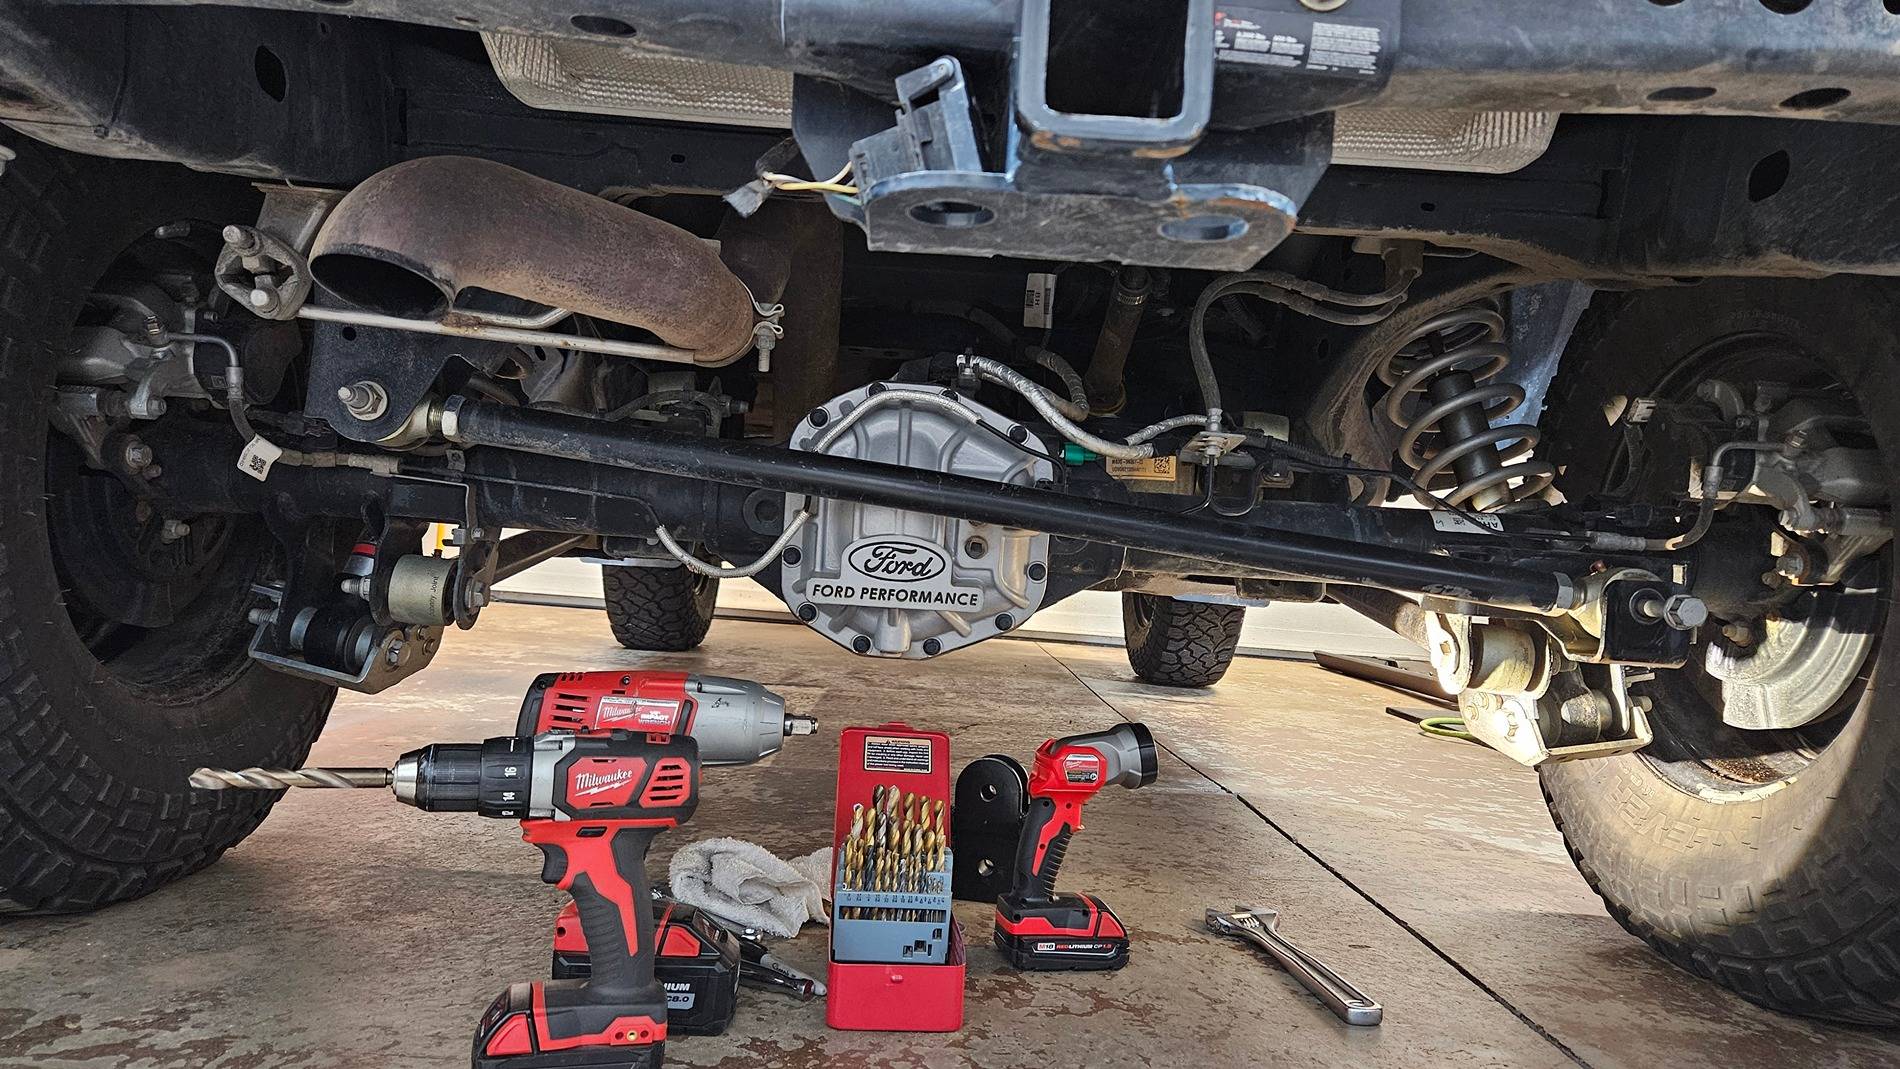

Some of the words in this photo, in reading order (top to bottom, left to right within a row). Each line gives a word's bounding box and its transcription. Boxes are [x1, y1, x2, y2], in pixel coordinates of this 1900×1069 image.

[863, 545, 934, 577] Ford
[812, 584, 856, 599] FORD
[860, 586, 979, 606] PERFORMANCE
[504, 766, 517, 778] 16
[575, 769, 633, 791] Milwaukee
[502, 791, 515, 802] 14
